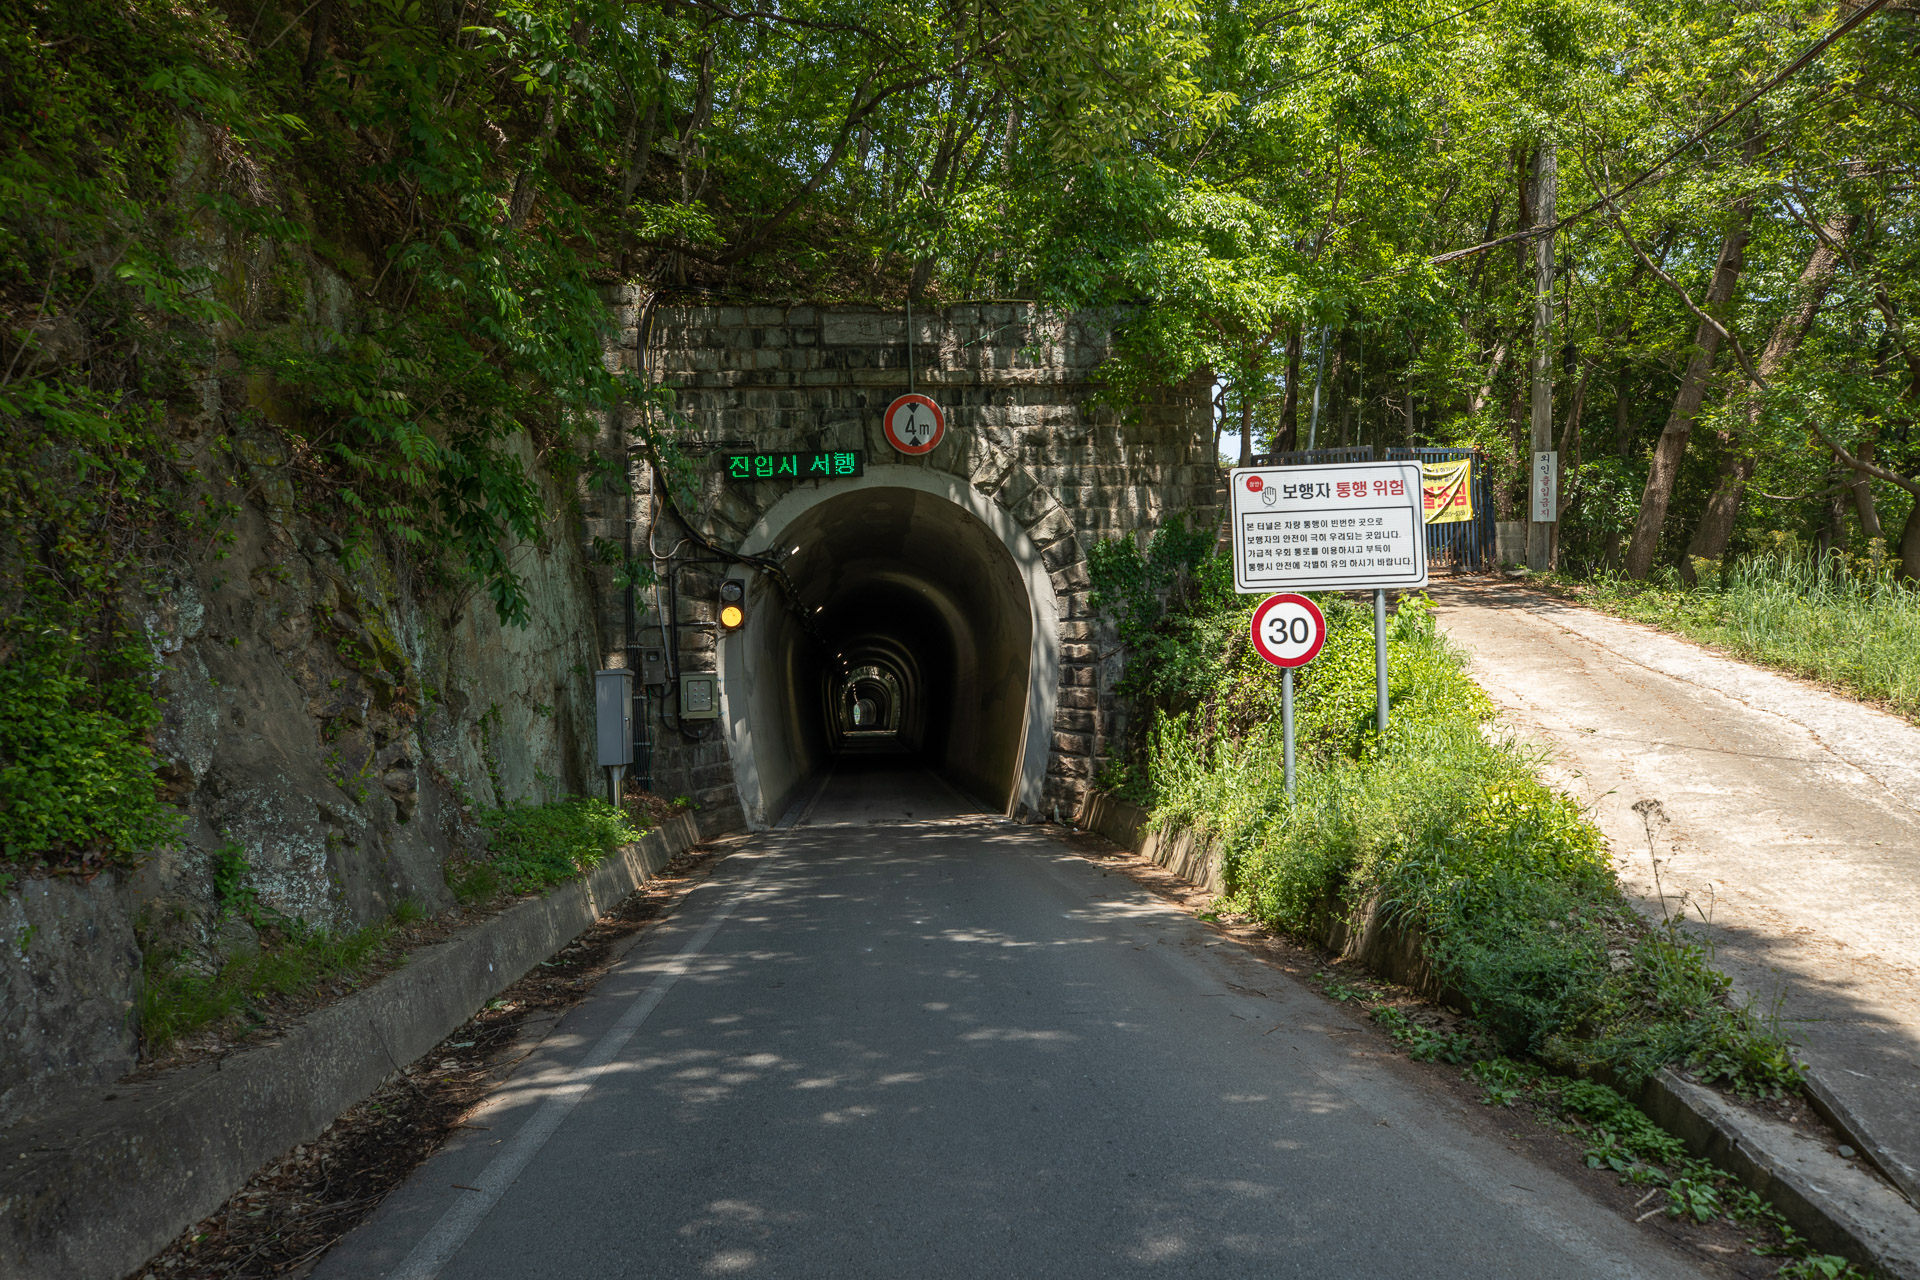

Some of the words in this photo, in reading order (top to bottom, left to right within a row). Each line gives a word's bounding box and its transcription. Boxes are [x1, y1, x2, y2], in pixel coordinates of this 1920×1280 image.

[905, 414, 916, 435] 4
[920, 423, 930, 435] m
[729, 455, 798, 478] 진입시
[810, 452, 855, 475] 서행
[1283, 483, 1330, 499] 보행자
[1336, 481, 1367, 498] 통행
[1373, 480, 1404, 496] 위험
[1246, 522, 1254, 531] 본
[1257, 522, 1281, 530] 터널은
[1284, 521, 1300, 529] 차량
[1304, 520, 1328, 529] 통행이
[1331, 518, 1356, 527] 빈번한
[1358, 517, 1383, 526] 곳으로
[1247, 535, 1280, 545] 보행자의
[1283, 534, 1307, 543] 안전이
[1310, 533, 1326, 541] 극히
[1329, 531, 1362, 541] 우려되는
[1365, 530, 1401, 540] 곳입니다.
[1248, 548, 1272, 557] 가급적
[1275, 548, 1291, 557] 우회
[1294, 546, 1318, 556] 통로를
[1322, 545, 1363, 555] 이용하시고
[1366, 544, 1391, 553] 부득이
[1249, 562, 1273, 571] 통행시
[1276, 561, 1300, 570] 안전에
[1303, 560, 1327, 569] 각별히
[1330, 559, 1347, 568] 유의
[1350, 558, 1374, 567] 하시기
[1377, 557, 1413, 566] 바랍니다.
[1268, 617, 1309, 644] 30
